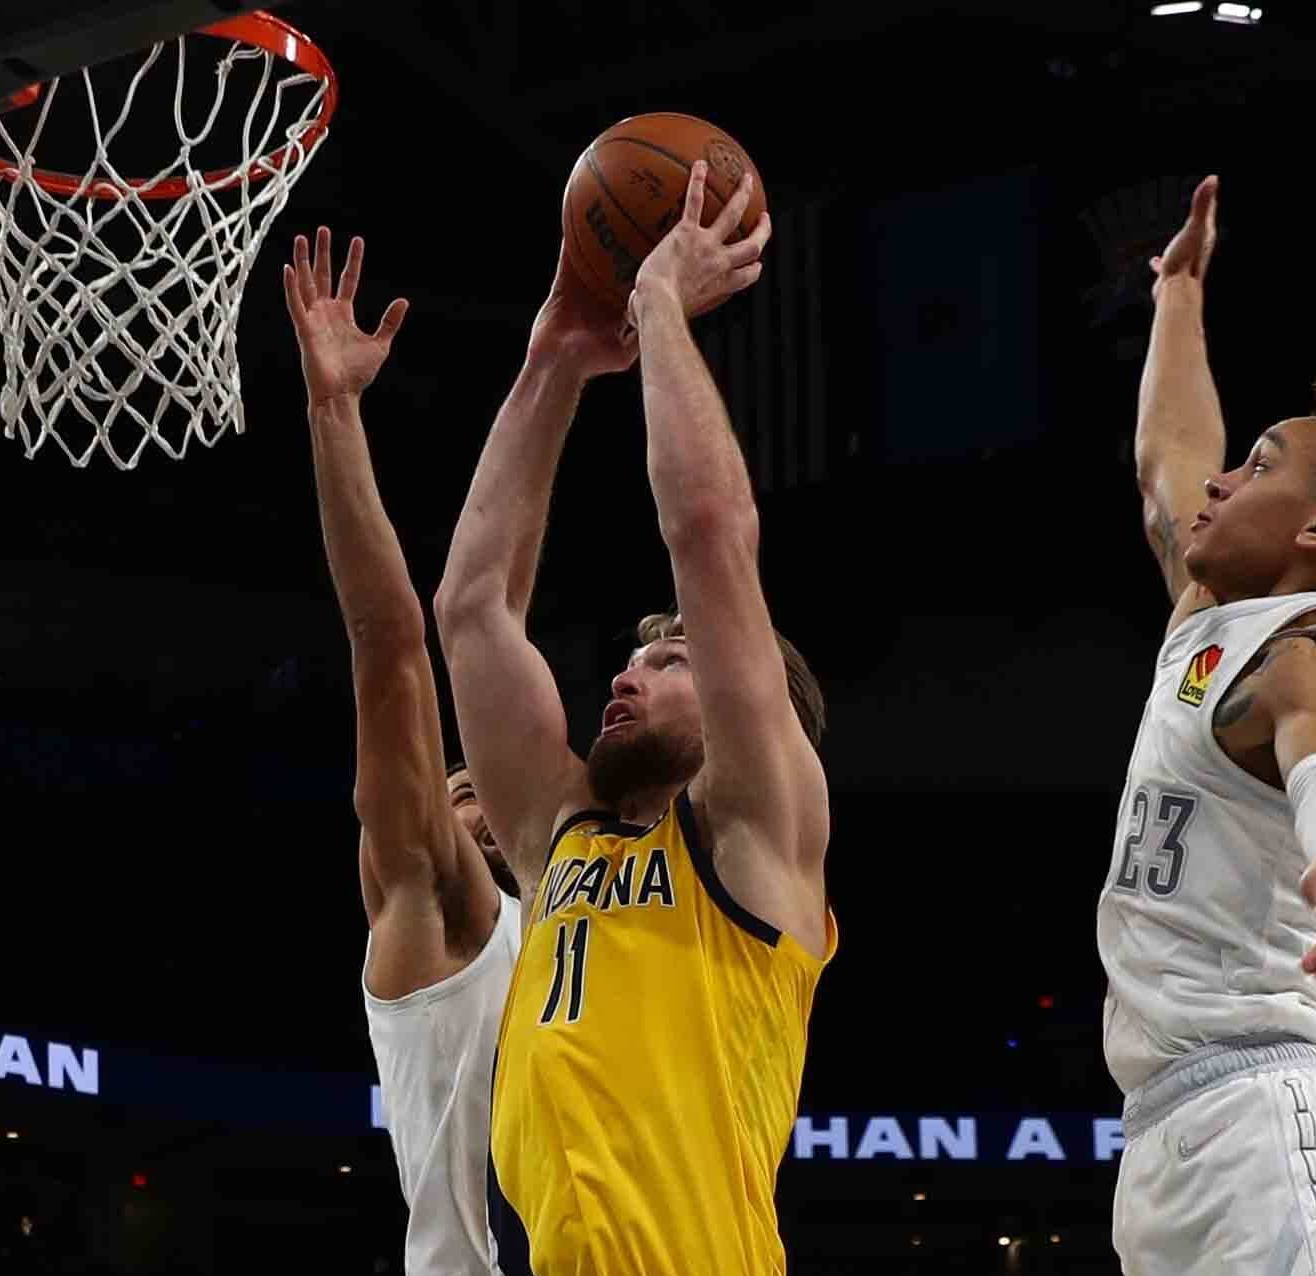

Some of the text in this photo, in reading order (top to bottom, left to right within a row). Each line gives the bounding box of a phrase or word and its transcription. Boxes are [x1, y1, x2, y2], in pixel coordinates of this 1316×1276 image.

[1117, 790, 1197, 898] 23
[537, 915, 589, 1027] 11
[793, 1116, 978, 1160] HAN
[1007, 1118, 1065, 1161] A
